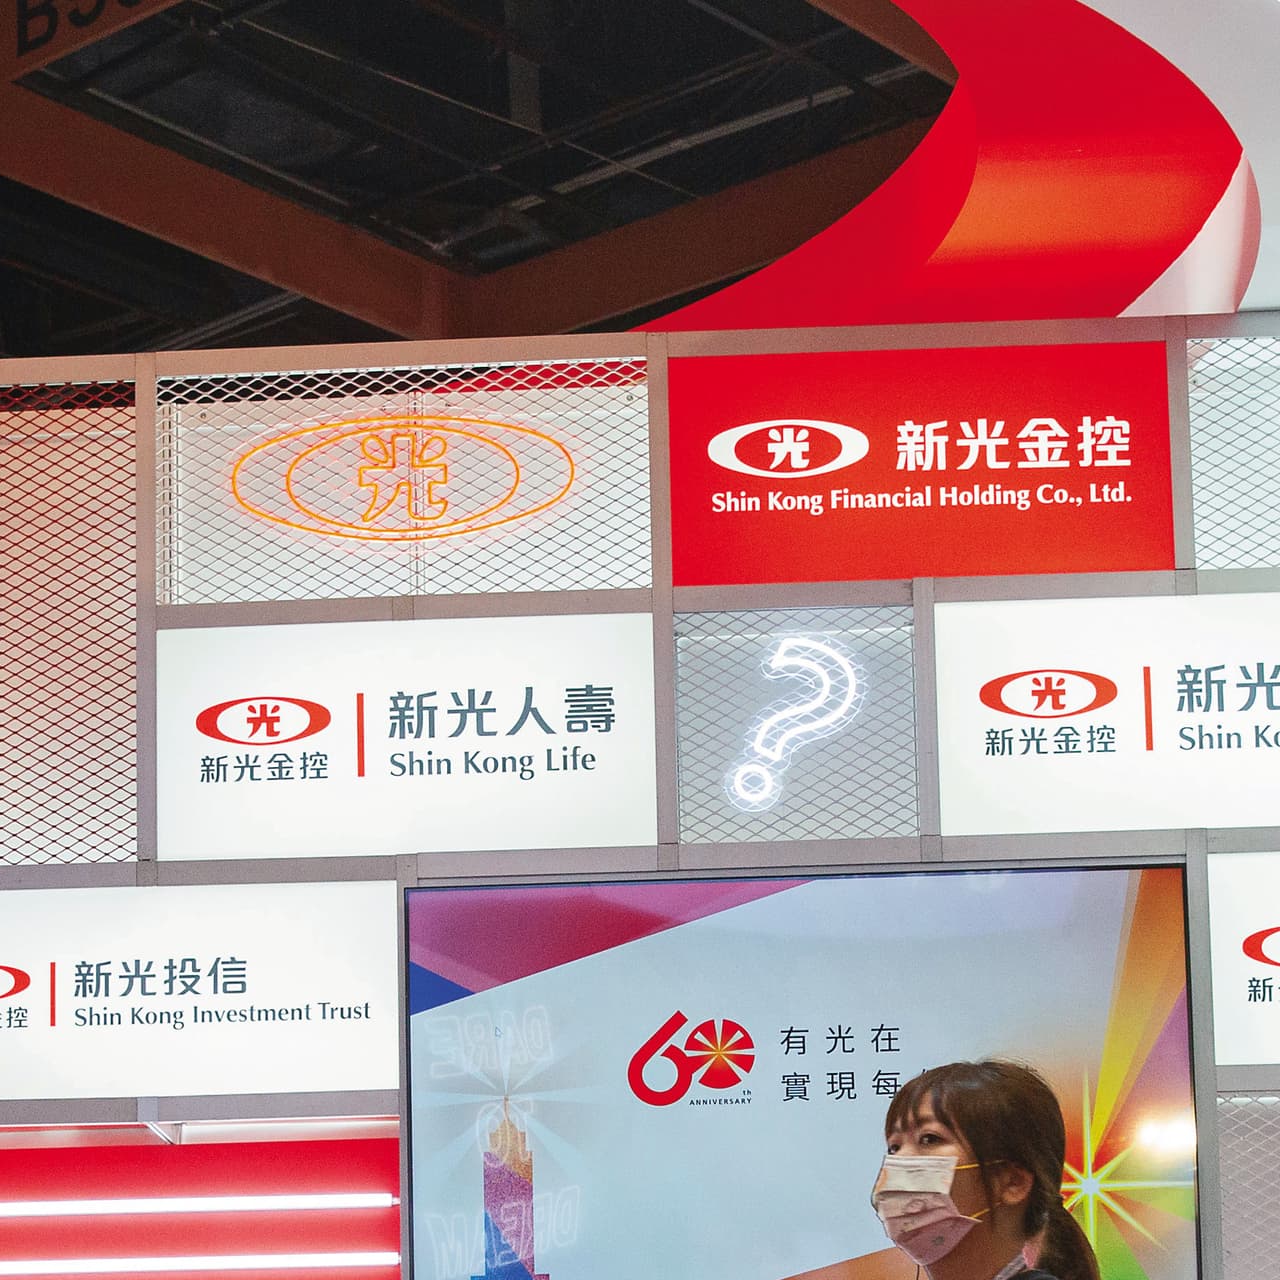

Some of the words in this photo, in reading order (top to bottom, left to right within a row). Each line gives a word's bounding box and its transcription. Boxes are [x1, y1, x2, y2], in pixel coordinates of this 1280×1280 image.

[895, 415, 1132, 472] 新光金控
[711, 490, 761, 513] Shin
[767, 490, 824, 516] Kong
[830, 485, 932, 510] Financial
[939, 483, 1031, 511] Holding
[1036, 483, 1083, 507] Co.,
[1089, 480, 1133, 503] Ltd.
[388, 684, 616, 740] 新光人壽
[985, 724, 1117, 757] 新光金控
[1178, 724, 1242, 751] Shin
[200, 751, 329, 784] 新光金控
[389, 750, 452, 777] Shin
[463, 750, 535, 781] Kong
[546, 745, 597, 772] Life
[73, 956, 248, 998] 新光投信
[74, 1006, 122, 1027] Shin
[131, 1007, 185, 1031] Kong
[193, 1003, 311, 1024] Investment
[317, 1001, 371, 1020] Trust
[780, 1023, 901, 1056] 有光在
[781, 1069, 928, 1103] 實現每
